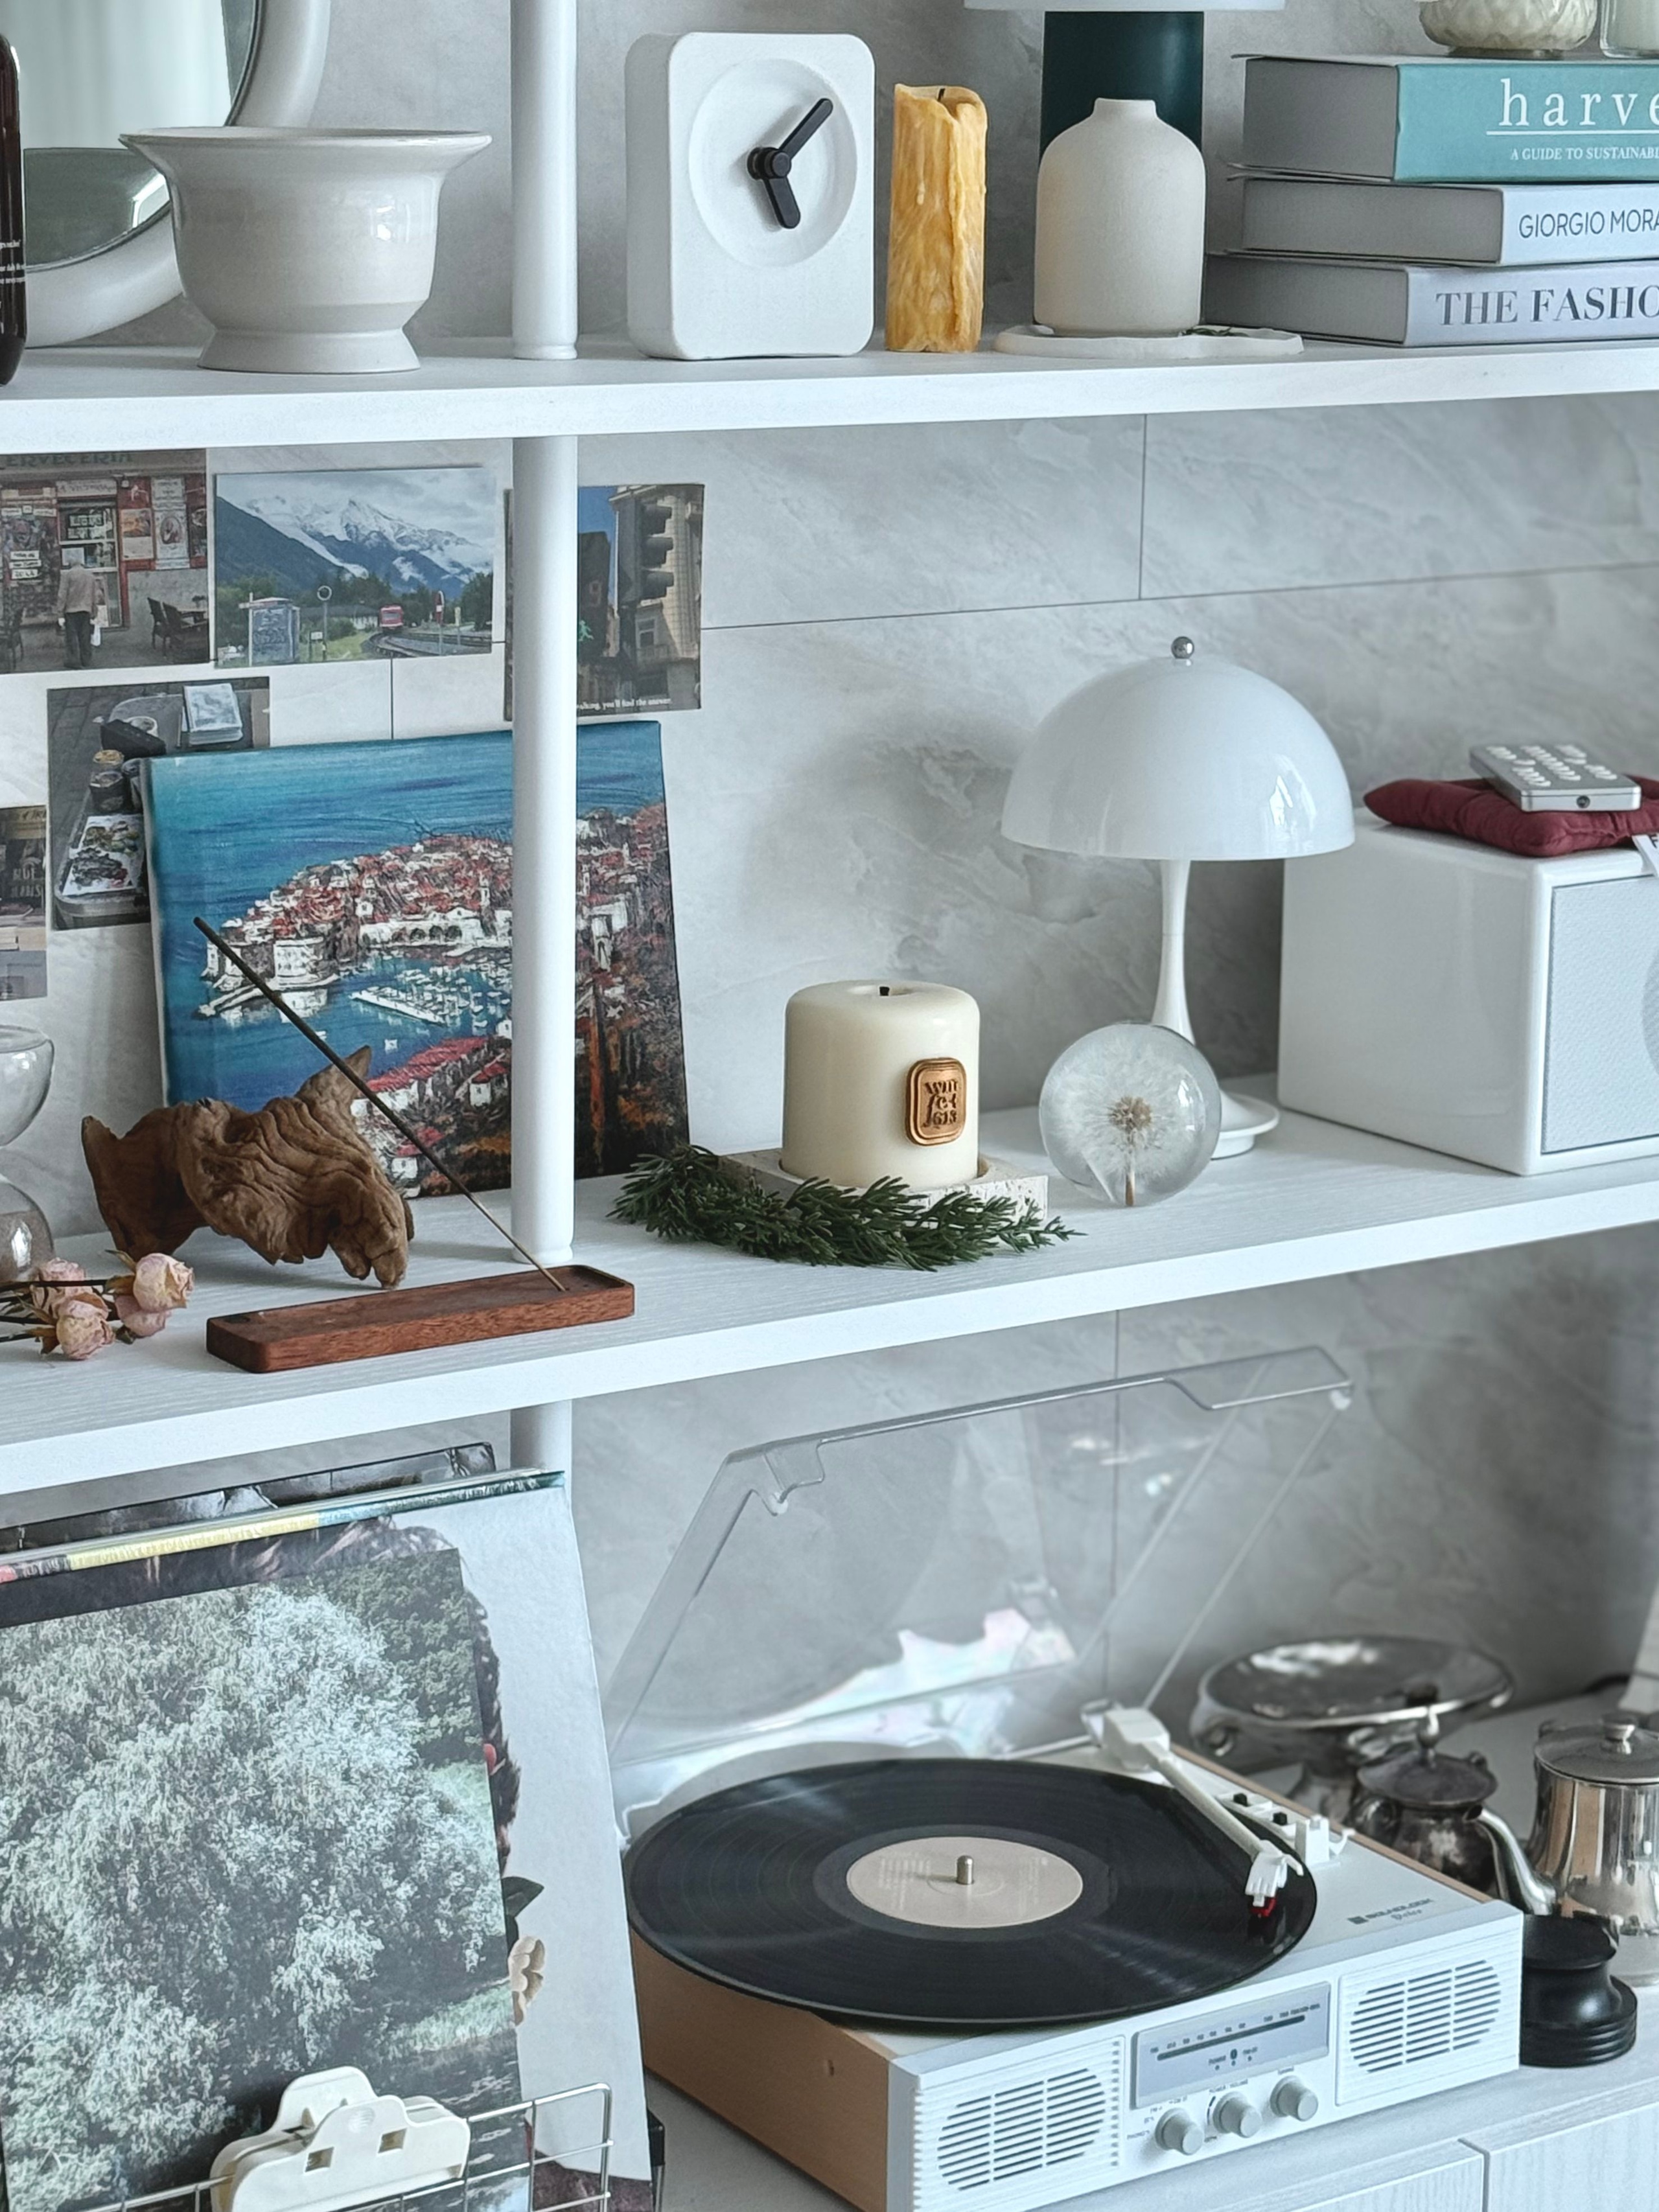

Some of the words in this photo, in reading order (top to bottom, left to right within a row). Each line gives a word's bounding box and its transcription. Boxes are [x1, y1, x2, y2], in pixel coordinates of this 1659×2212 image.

[1510, 148, 1519, 160] A
[1522, 148, 1562, 160] GUIDE
[1566, 147, 1583, 160] TO
[1519, 211, 1605, 238] GIORGIO
[1435, 290, 1518, 325] THE
